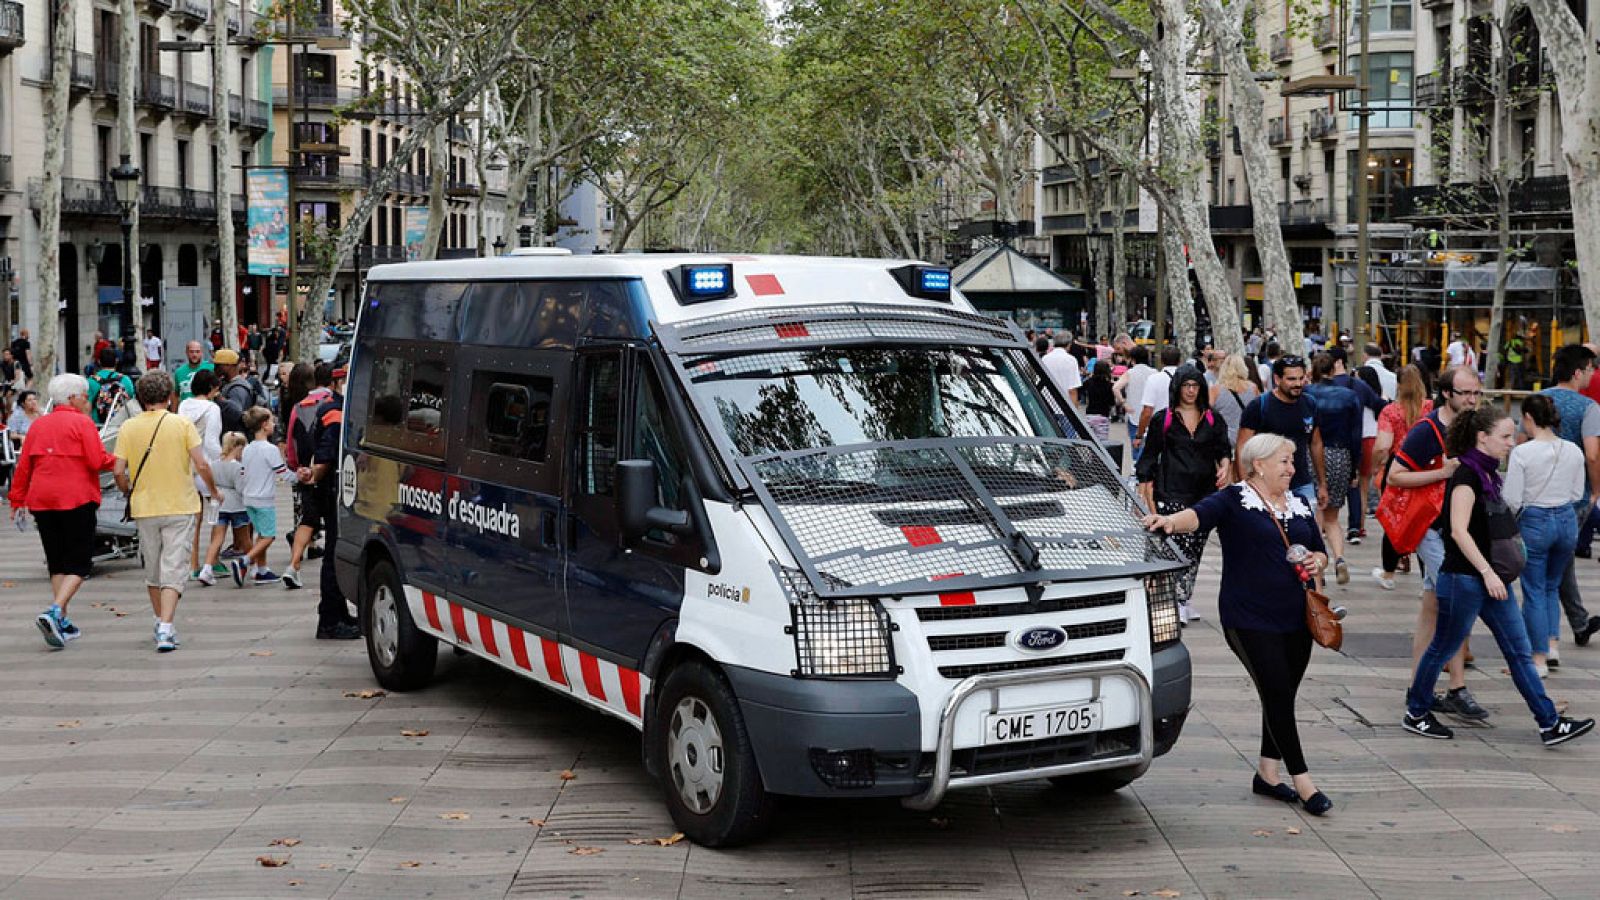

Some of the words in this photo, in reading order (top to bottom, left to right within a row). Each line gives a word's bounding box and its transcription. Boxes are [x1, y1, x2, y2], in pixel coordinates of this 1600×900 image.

[398, 483, 442, 515] mossos
[448, 490, 519, 538] d'esquadra
[707, 582, 741, 602] policia
[1027, 630, 1057, 646] Ford
[996, 715, 1034, 740] CME
[1045, 708, 1092, 735] 1705
[1557, 722, 1572, 734] N
